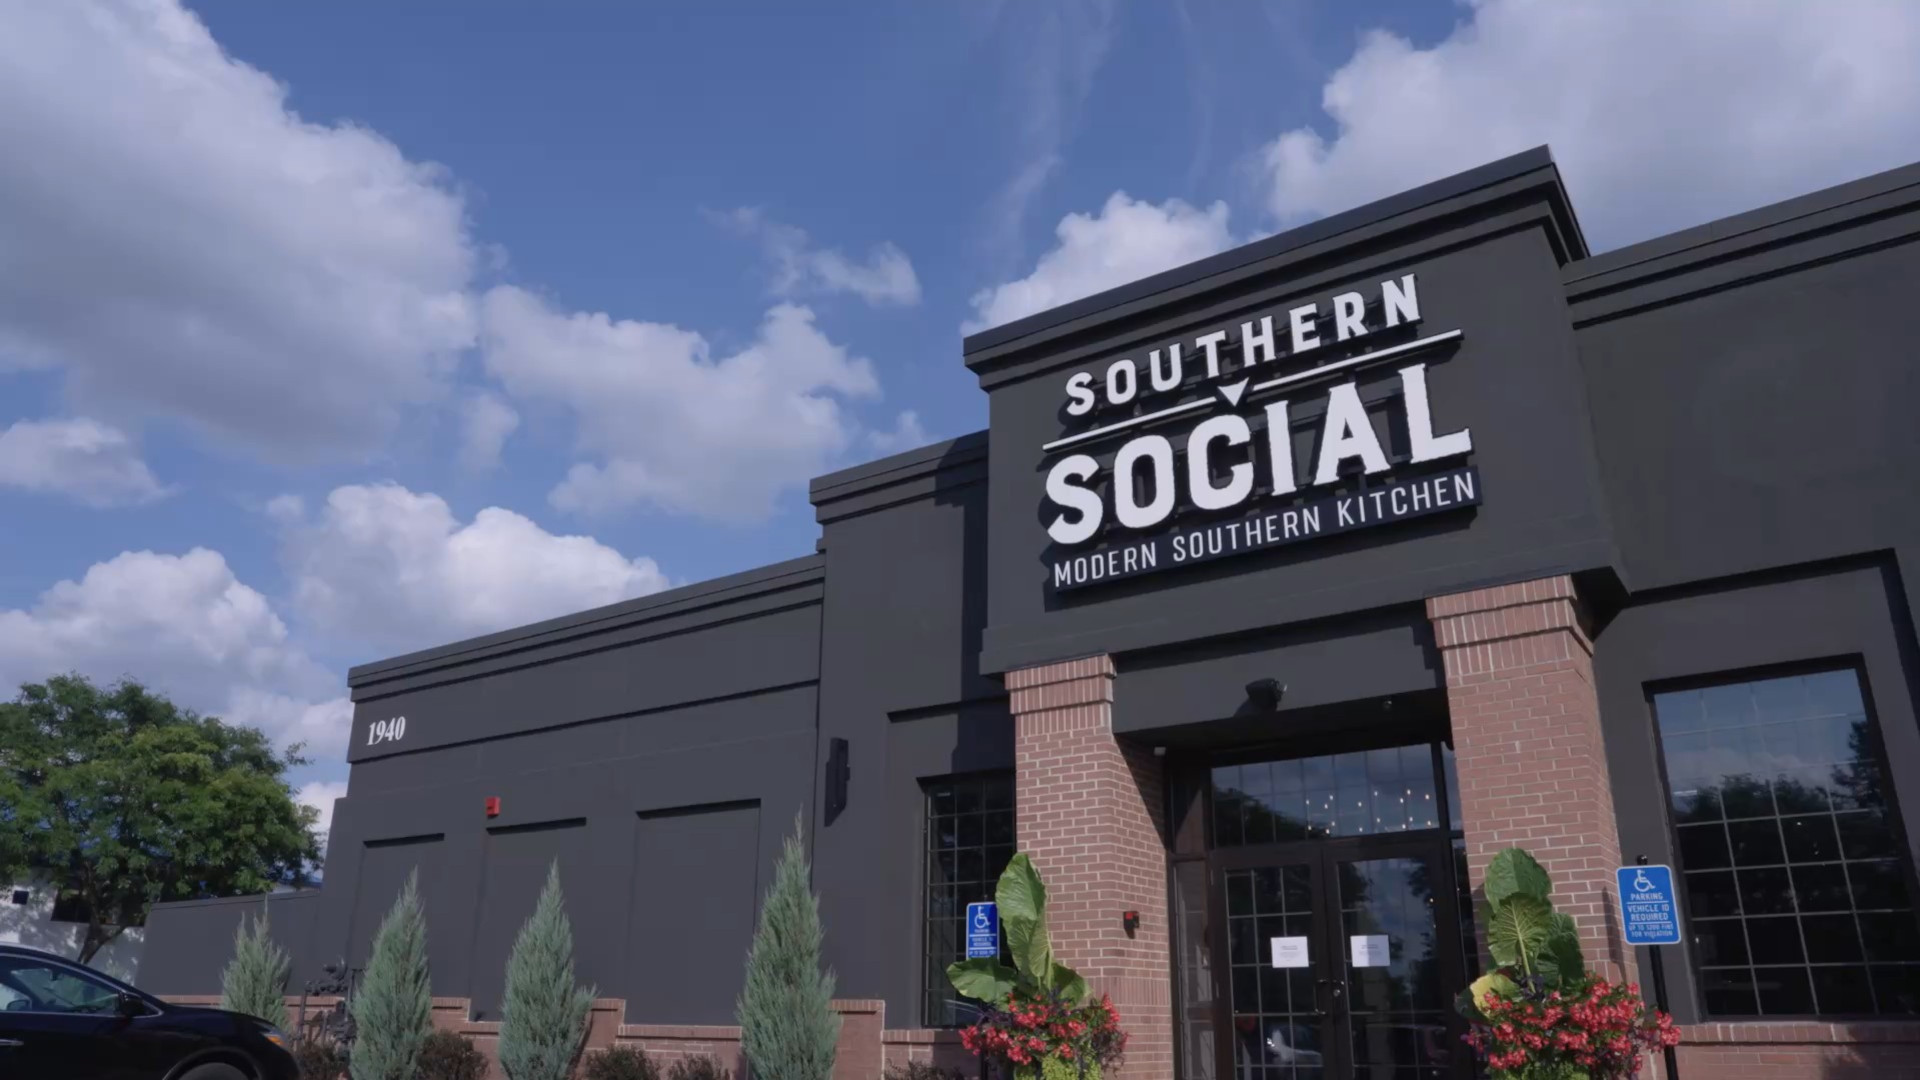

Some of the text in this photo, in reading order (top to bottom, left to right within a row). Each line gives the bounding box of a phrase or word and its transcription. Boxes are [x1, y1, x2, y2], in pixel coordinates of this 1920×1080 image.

[1065, 273, 1421, 416] SOUTHERN
[1045, 363, 1473, 545] SOCIAL
[1054, 472, 1476, 587] MODERN SOUTHERN KITCHEN
[366, 715, 406, 746] 1940
[1627, 904, 1670, 913] VEHICLE ID
[1630, 913, 1669, 922] REQUIRED
